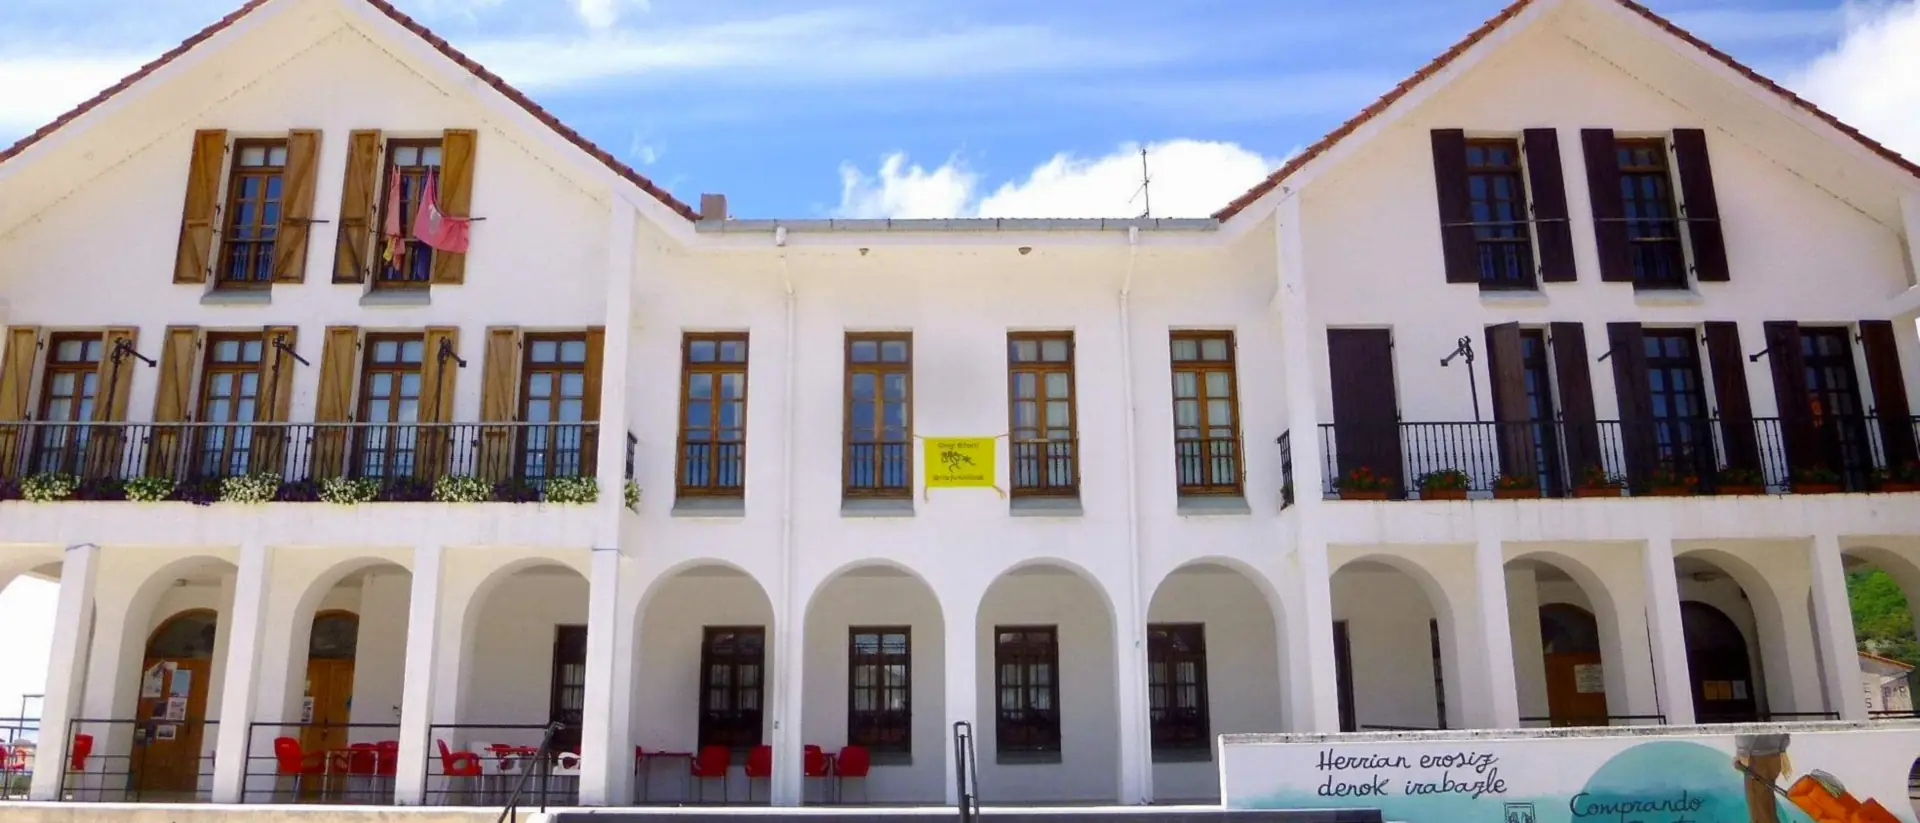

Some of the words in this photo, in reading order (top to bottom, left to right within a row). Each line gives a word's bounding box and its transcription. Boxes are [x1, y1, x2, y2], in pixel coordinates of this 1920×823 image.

[1316, 748, 1411, 771] Herrian
[1419, 751, 1499, 773] erosiz
[1318, 774, 1390, 797] denok
[1405, 767, 1507, 799] irabazle
[1570, 789, 1705, 823] Comprando
